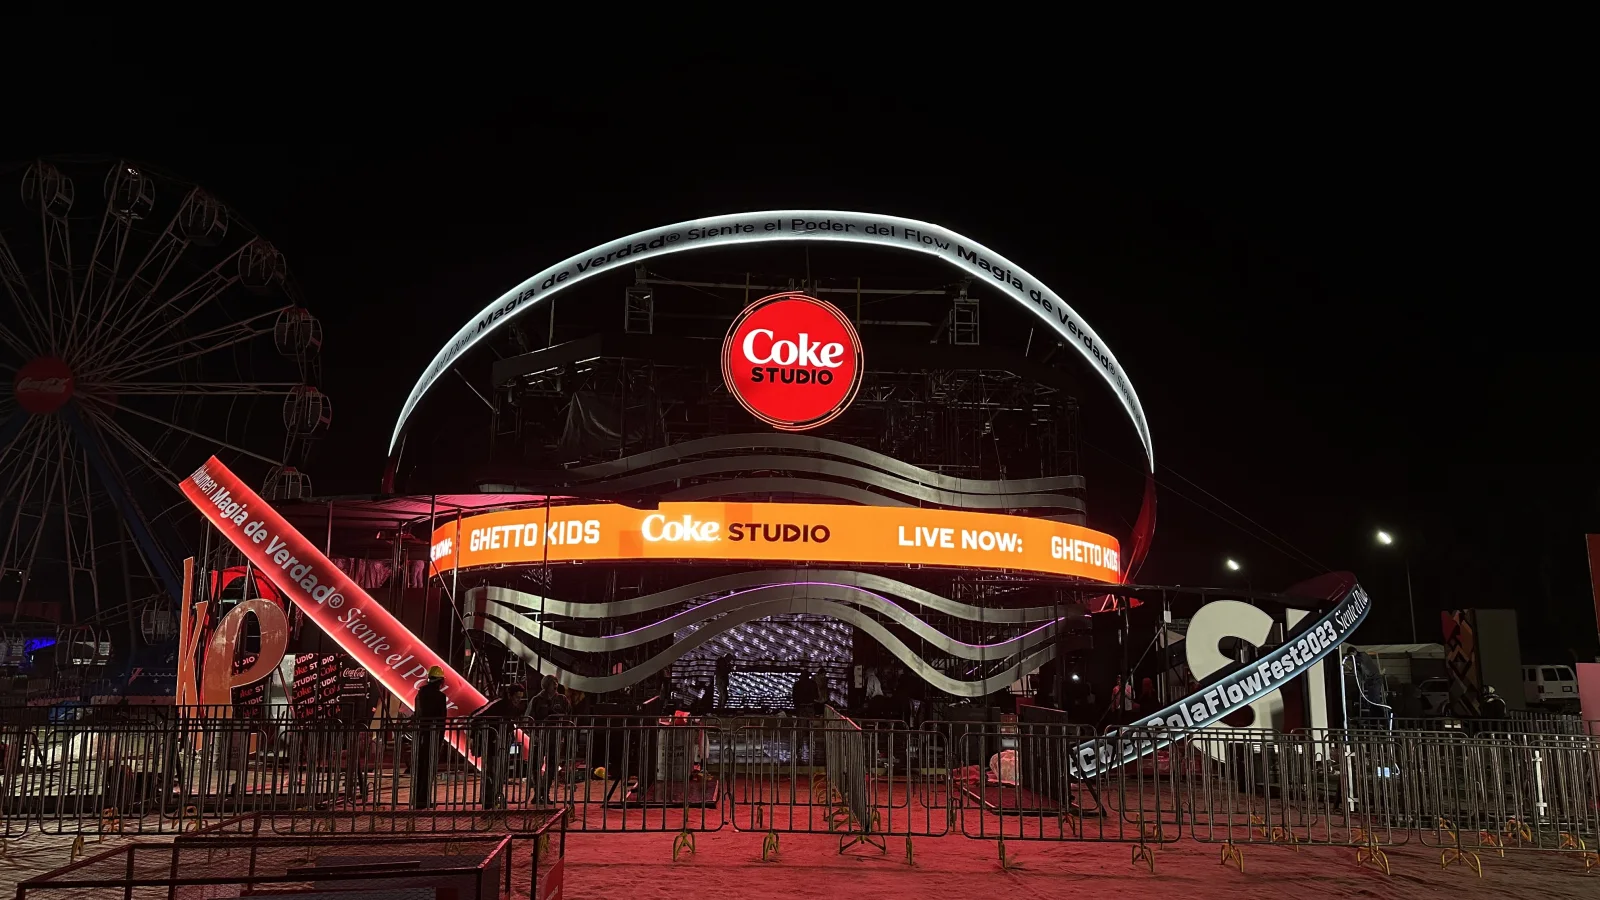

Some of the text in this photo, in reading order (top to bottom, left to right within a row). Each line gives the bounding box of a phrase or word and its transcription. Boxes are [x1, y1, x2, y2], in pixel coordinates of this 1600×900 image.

[476, 288, 535, 334] Magia
[541, 270, 569, 290] de
[688, 223, 755, 241] Siente
[764, 219, 781, 232] el
[791, 218, 855, 232] Poder
[865, 222, 895, 237] del
[904, 228, 951, 251] Flow
[957, 244, 1024, 293] Magia
[1029, 290, 1053, 312] de
[742, 328, 844, 368] Coke
[751, 366, 834, 385] STUDIO
[470, 523, 538, 552] GHETTO
[543, 519, 600, 545] KIDS
[641, 513, 721, 542] Coke
[728, 522, 831, 543] STUDIO
[897, 525, 955, 548] LIVE
[961, 528, 1023, 553] NOW:
[1051, 535, 1102, 567] GHETTO
[1103, 546, 1118, 572] KIDS
[210, 487, 249, 526] Magia
[243, 521, 268, 543] de
[337, 607, 391, 655] Siente
[385, 652, 415, 670] el
